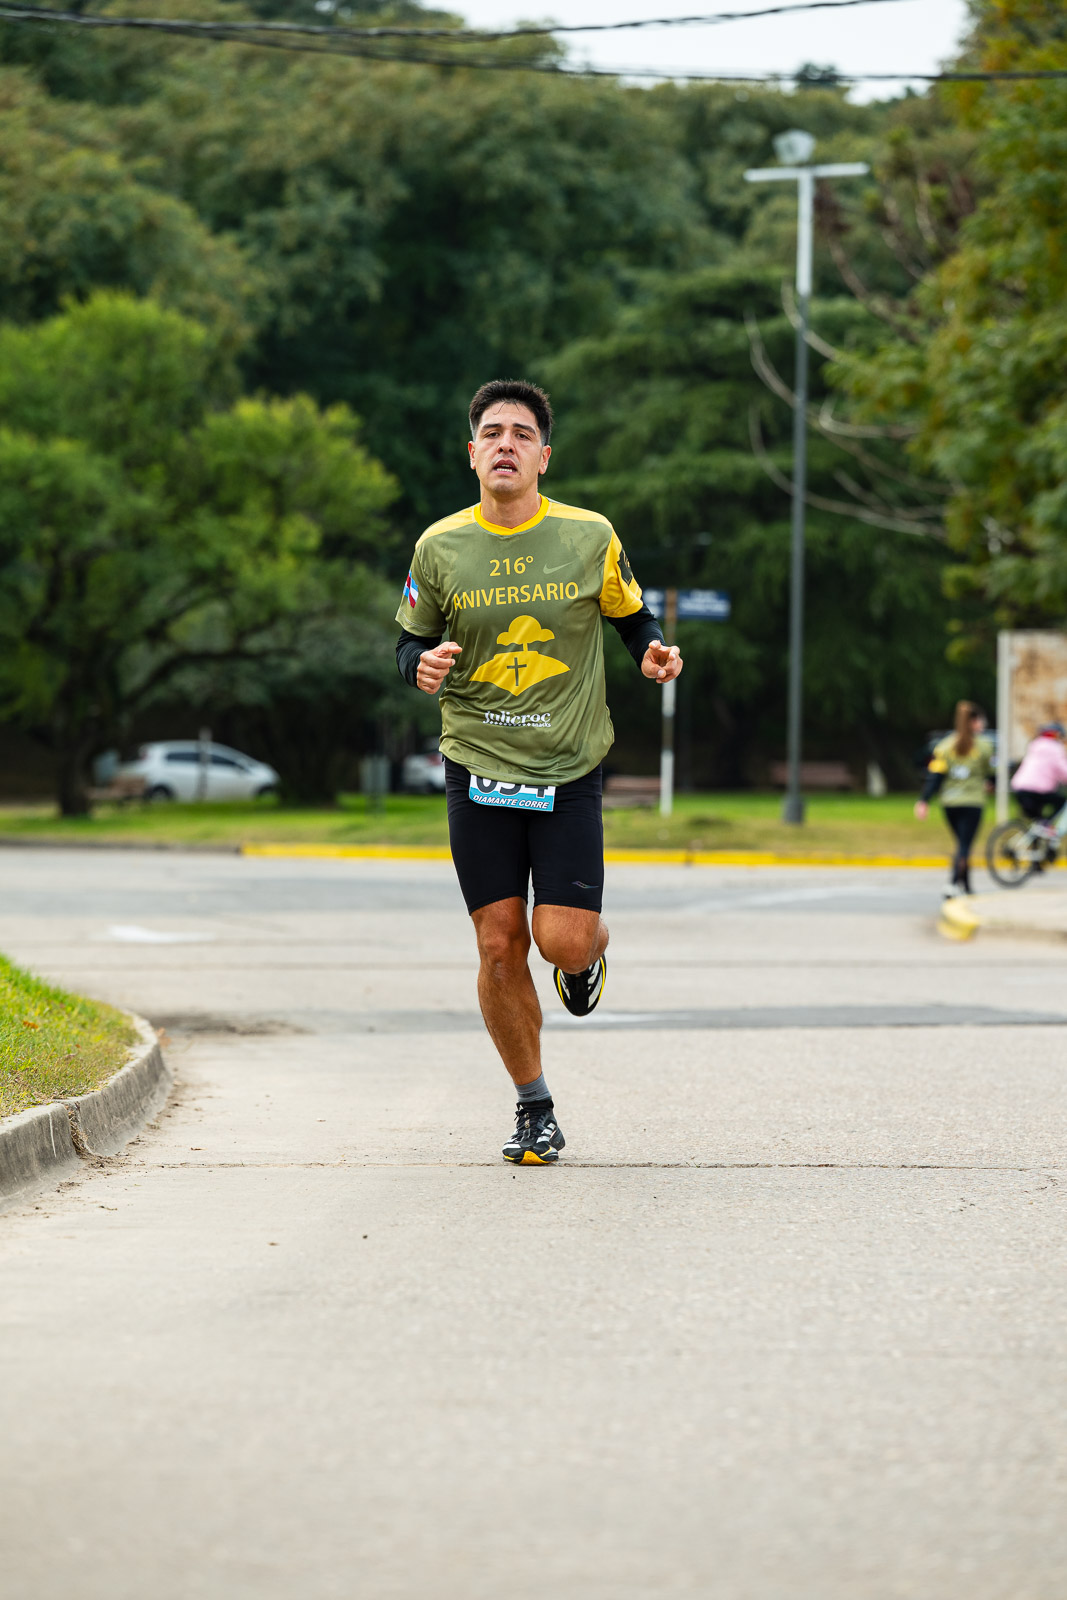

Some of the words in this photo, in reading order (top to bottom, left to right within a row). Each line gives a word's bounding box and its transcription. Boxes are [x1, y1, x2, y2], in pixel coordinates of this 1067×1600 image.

[489, 555, 534, 577] 216°
[453, 582, 579, 610] ANIVERSARIO
[472, 794, 518, 806] DIAMANTE
[518, 800, 550, 809] CORRE
